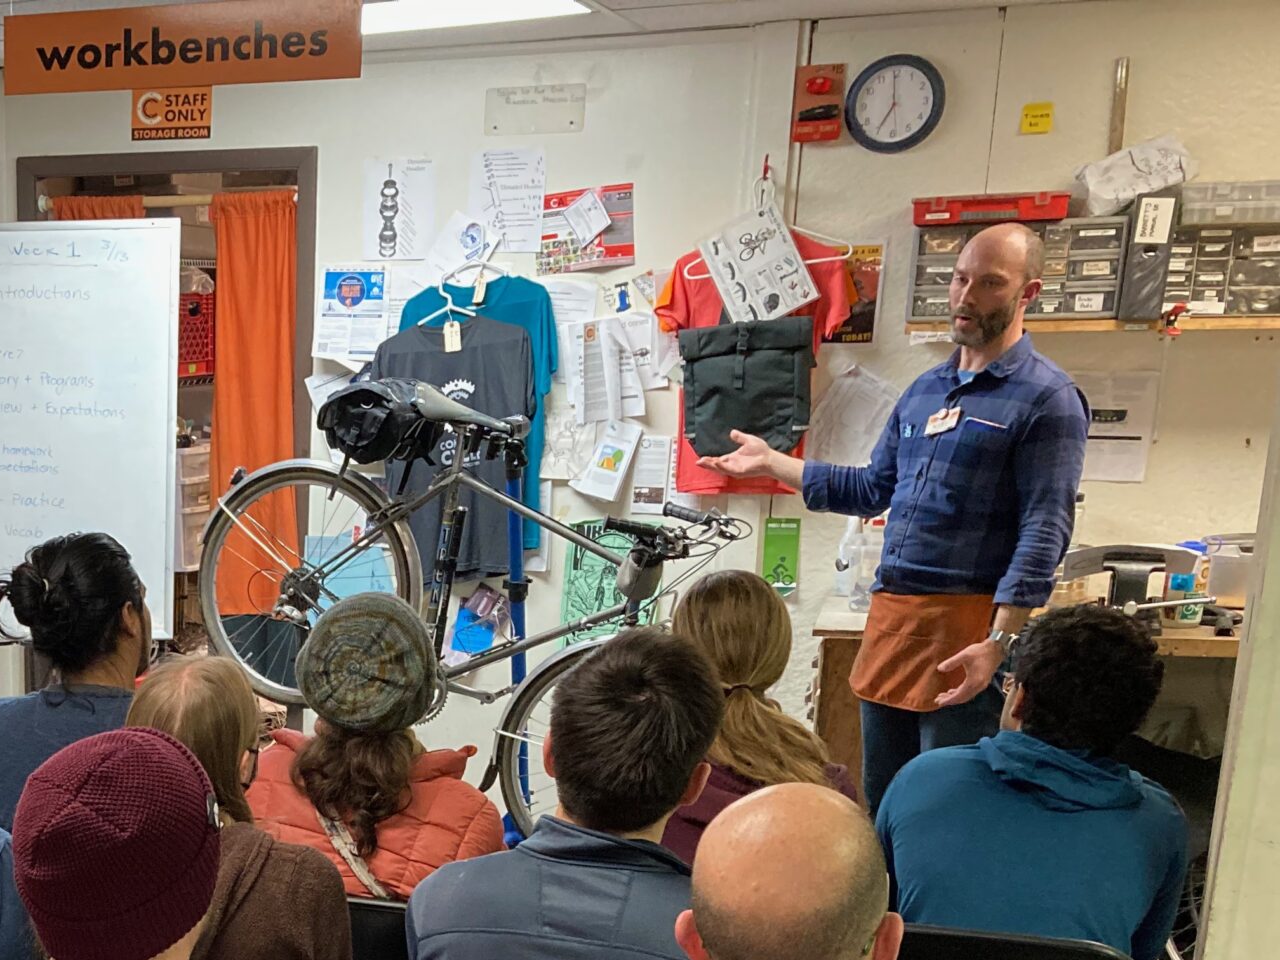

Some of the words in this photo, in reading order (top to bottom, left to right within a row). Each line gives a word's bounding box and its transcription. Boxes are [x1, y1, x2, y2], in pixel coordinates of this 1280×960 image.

[36, 20, 328, 71] workbenches
[165, 94, 208, 107] STAFF
[164, 108, 208, 122] ONLY
[134, 129, 176, 139] STORAGE
[178, 128, 209, 138] ROOM
[8, 241, 60, 256] Week
[67, 240, 81, 258] 1
[39, 372, 95, 395] Programs
[45, 400, 127, 420] Expectations
[2, 442, 54, 458] homework
[12, 492, 65, 509] Practice
[4, 524, 44, 538] Vocab
